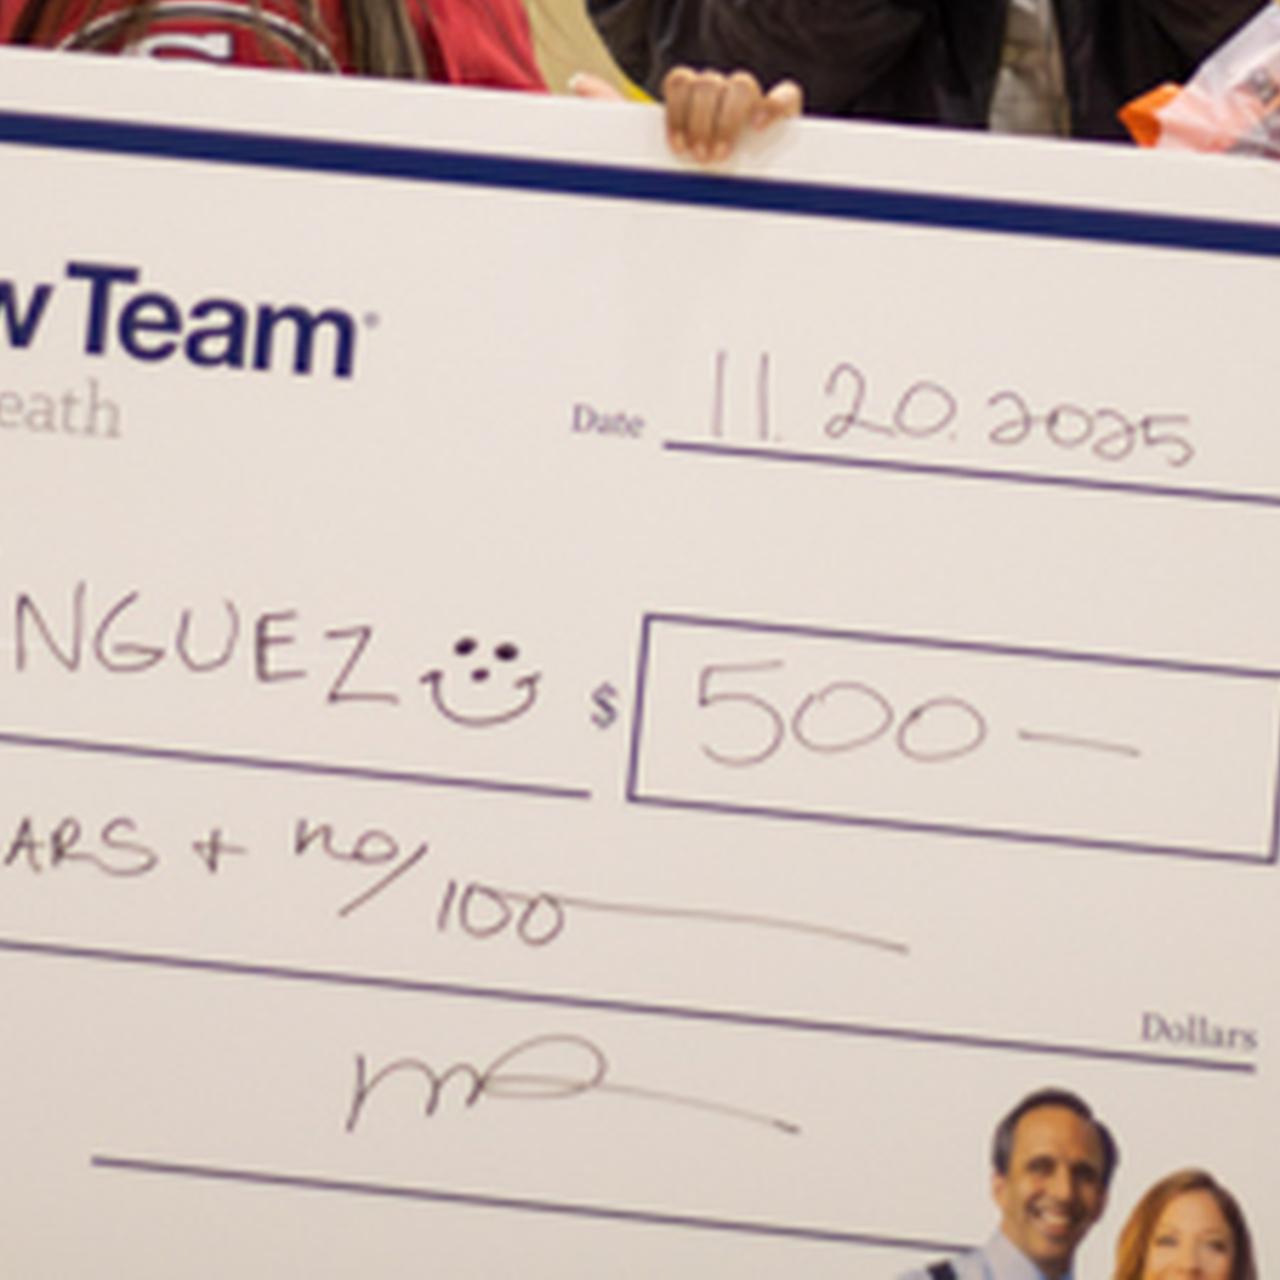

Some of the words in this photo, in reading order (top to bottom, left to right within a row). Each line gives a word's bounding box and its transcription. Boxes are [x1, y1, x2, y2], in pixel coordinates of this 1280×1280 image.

[571, 403, 646, 439] Date
[588, 681, 621, 730] $
[1139, 1009, 1260, 1053] Dollars
